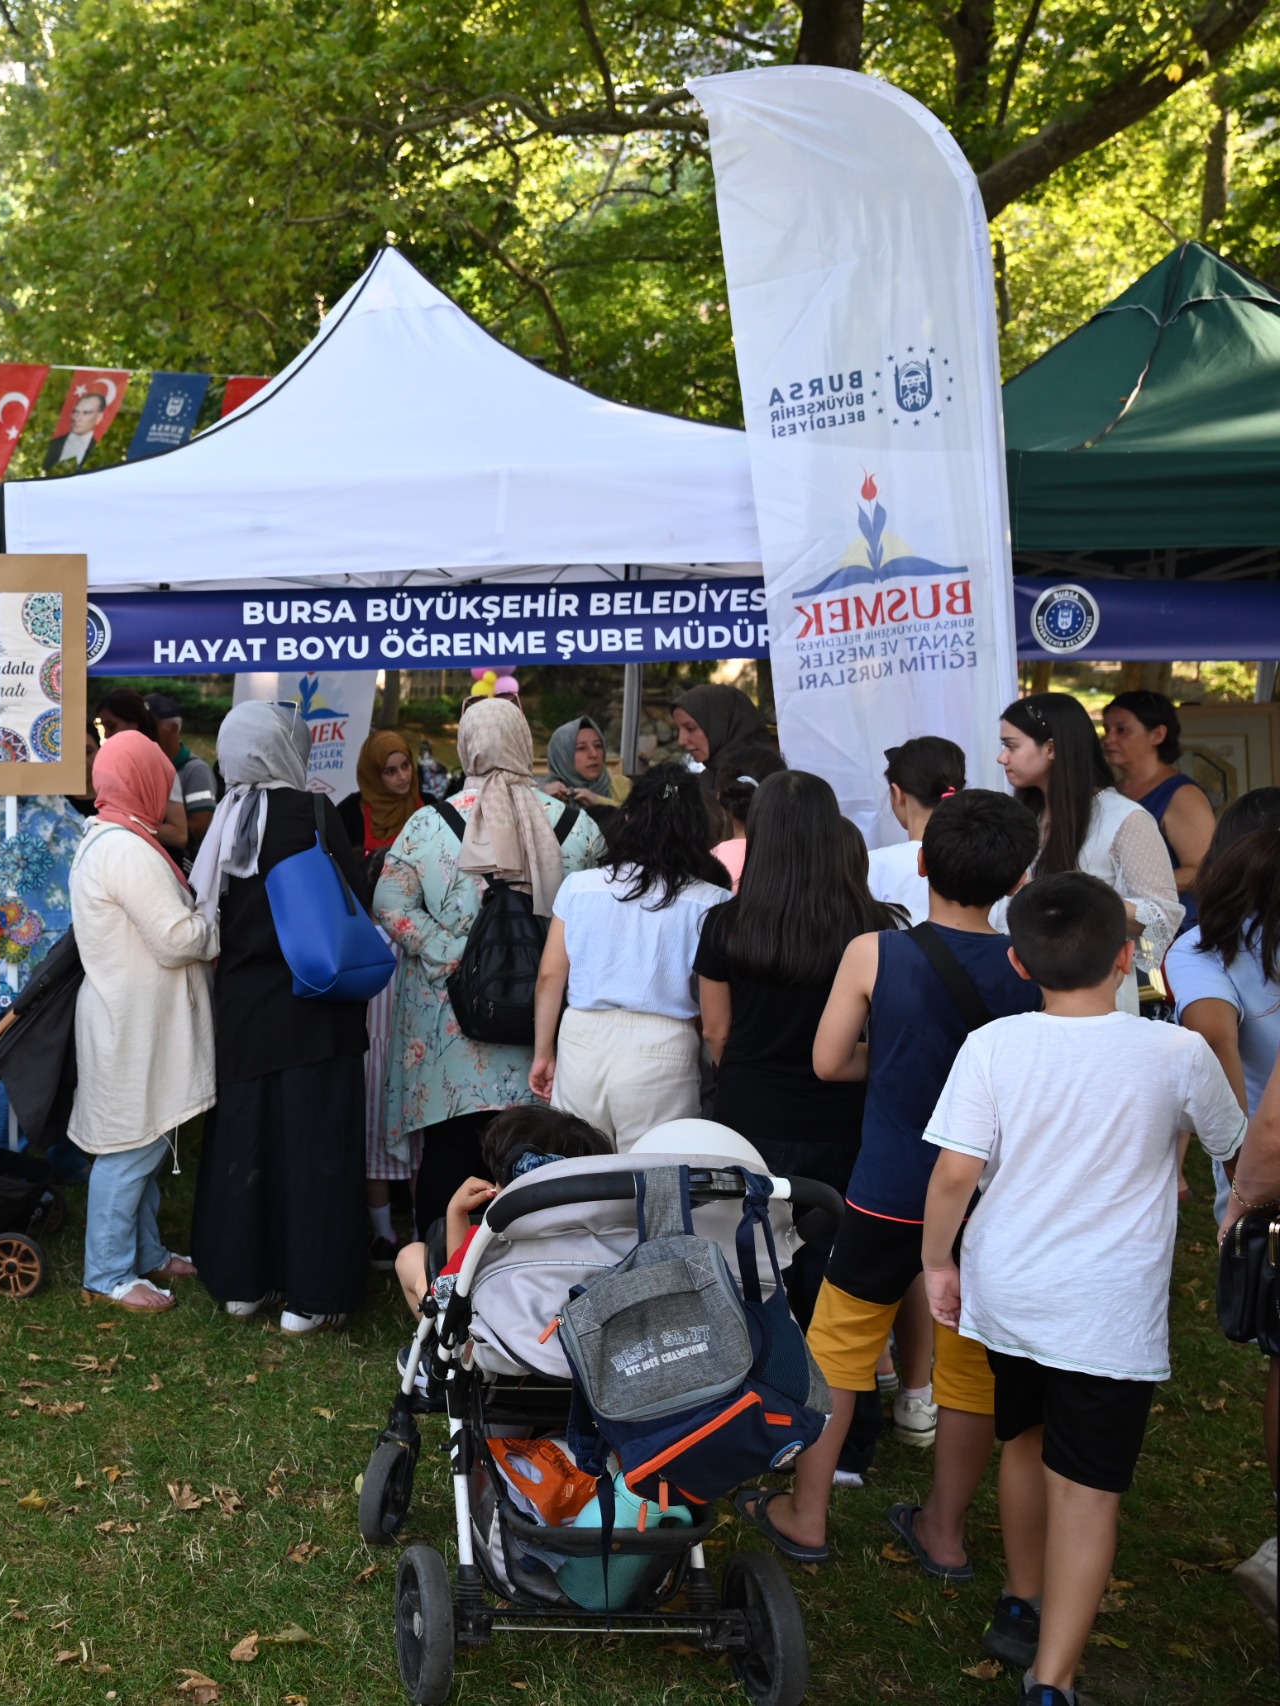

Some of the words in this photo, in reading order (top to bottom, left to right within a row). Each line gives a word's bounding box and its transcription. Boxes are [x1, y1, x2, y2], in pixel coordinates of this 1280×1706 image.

[242, 599, 357, 625] BURSA
[365, 587, 579, 627] BÜYÜKŞEHİR
[589, 583, 767, 617] BELEDİYES
[1053, 590, 1079, 601] BURSA
[87, 630, 105, 659] LEDİYESİ
[153, 638, 267, 664] HAYAT
[276, 635, 370, 661] BOYU
[379, 628, 547, 658] ÖĞRENME
[556, 627, 644, 660] ŞUBE
[653, 618, 770, 651] MÜDÜR
